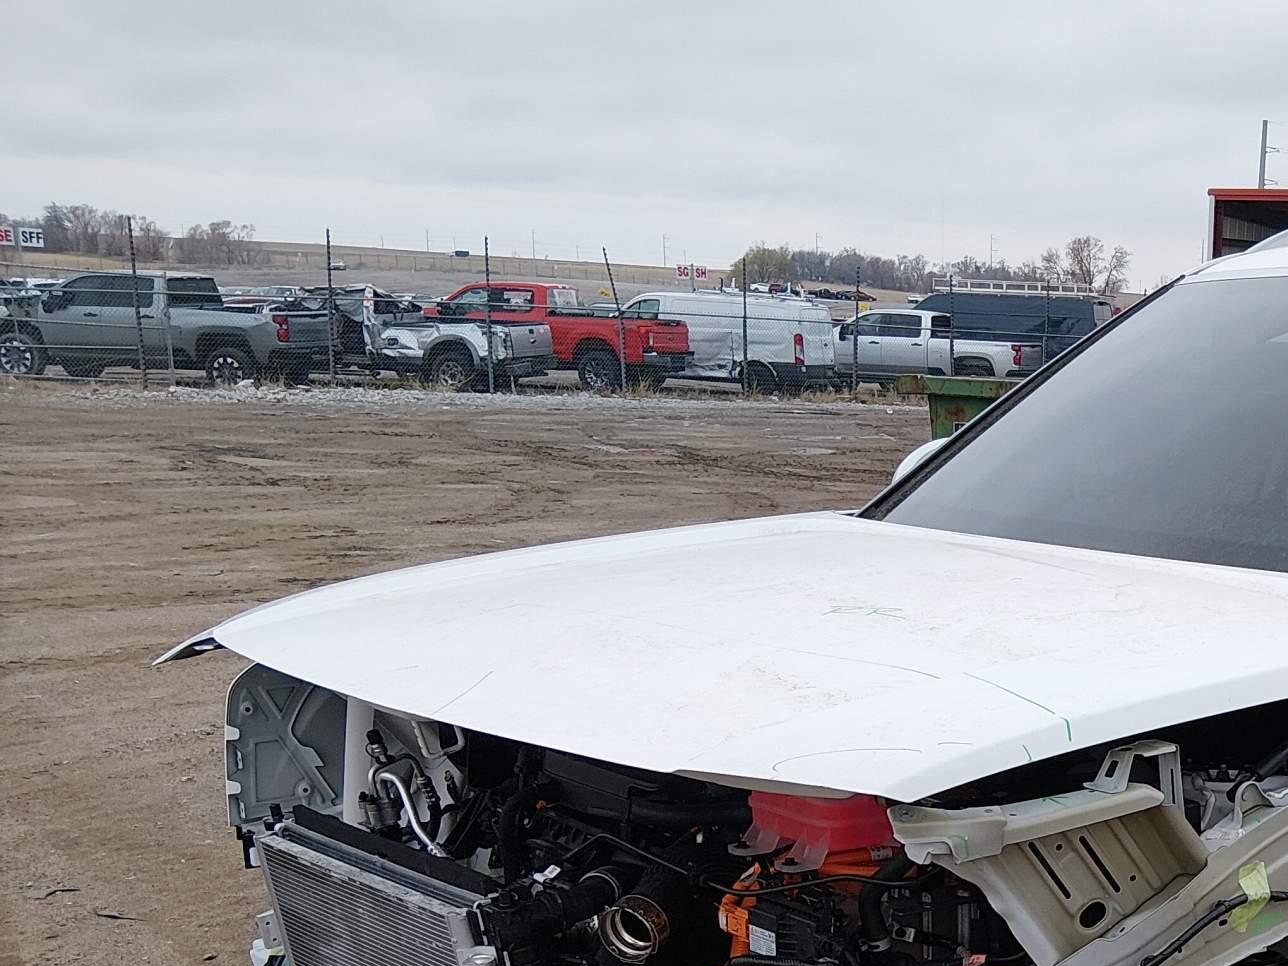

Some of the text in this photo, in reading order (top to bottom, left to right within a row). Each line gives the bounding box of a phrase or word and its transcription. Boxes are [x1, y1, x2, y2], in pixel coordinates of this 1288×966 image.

[21, 230, 43, 244] SFF
[677, 267, 689, 277] SG
[695, 268, 707, 279] SH
